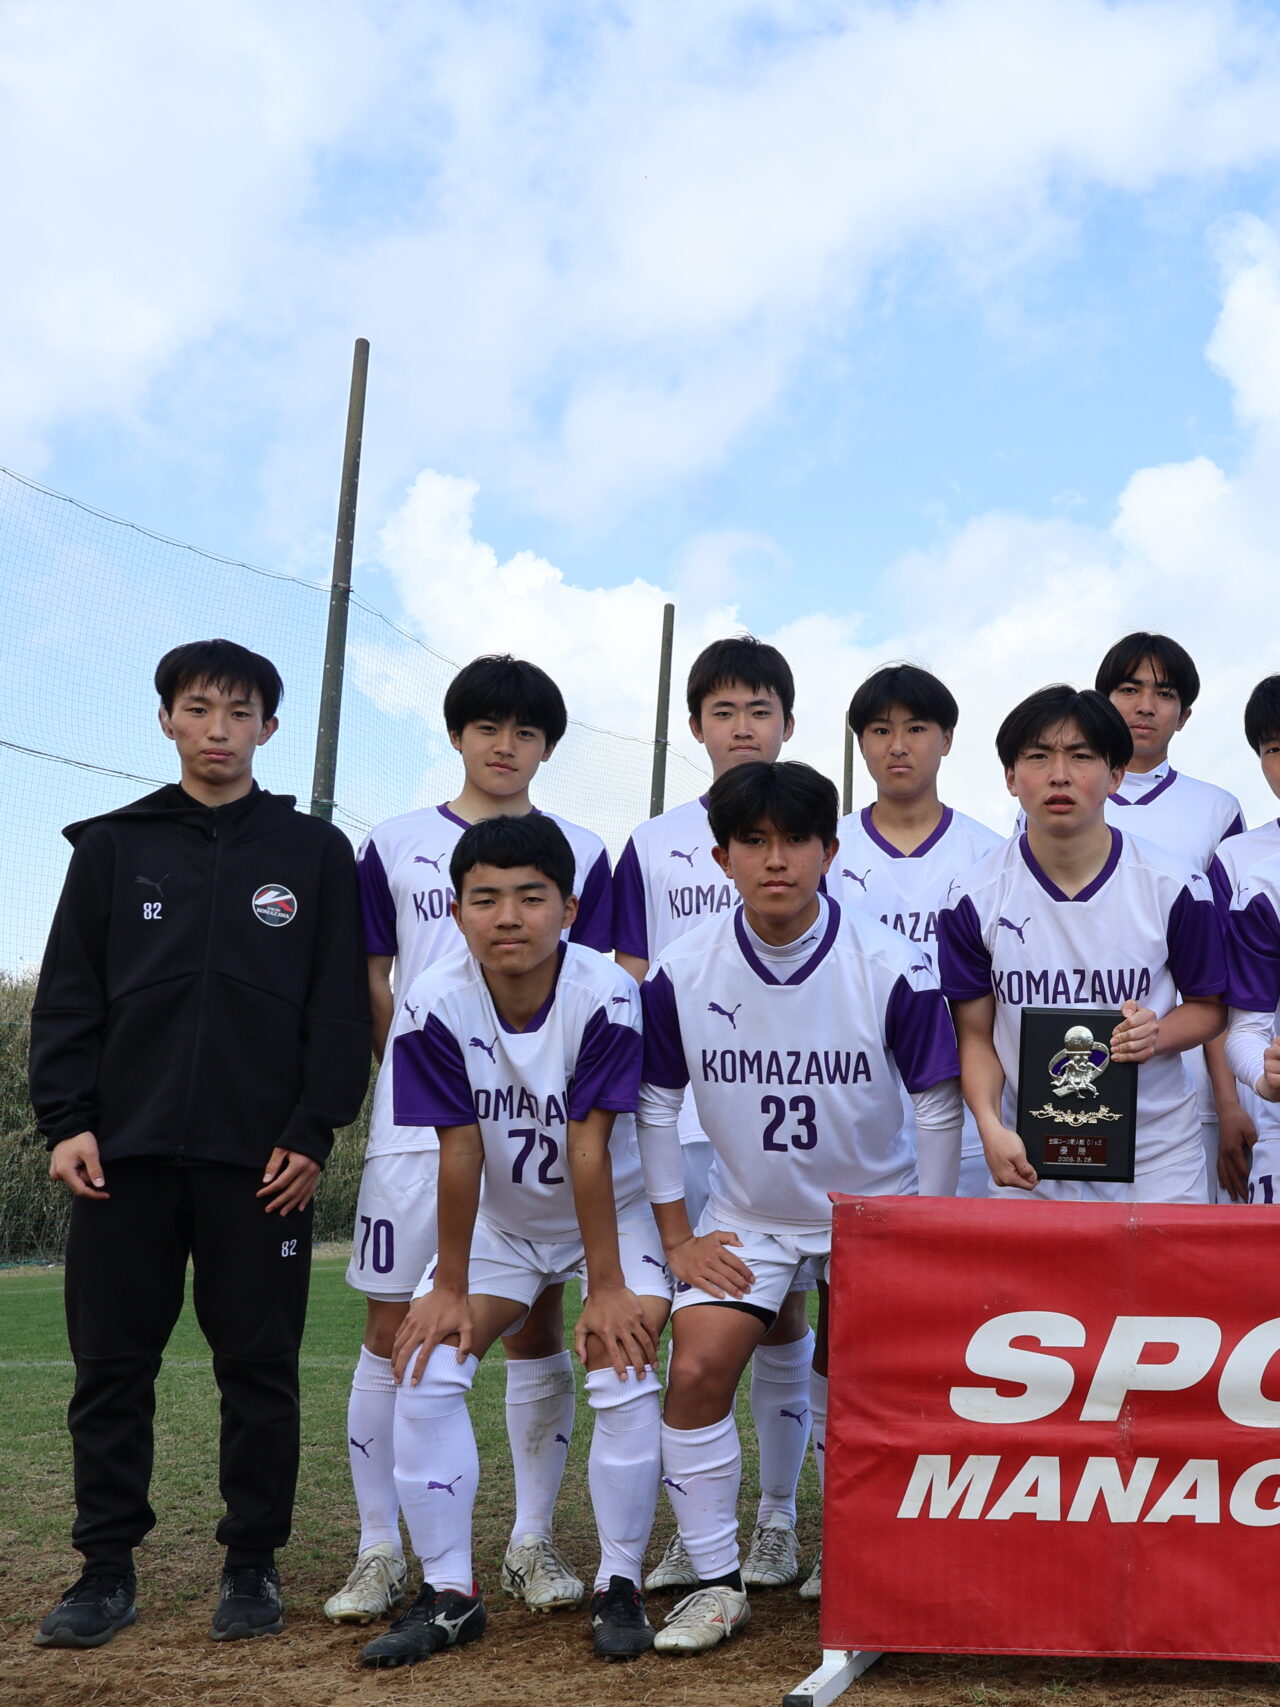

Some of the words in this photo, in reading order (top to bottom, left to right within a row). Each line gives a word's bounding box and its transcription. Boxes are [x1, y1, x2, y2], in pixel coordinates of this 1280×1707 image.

[143, 902, 162, 920] 82
[880, 911, 939, 943] AZA
[992, 967, 1151, 1006] KOMAZAWA
[702, 1049, 872, 1085] KOMAZAWA
[761, 1095, 818, 1152] 23
[508, 1128, 565, 1184] 72
[281, 1239, 298, 1257] 82
[360, 1215, 395, 1274] 70
